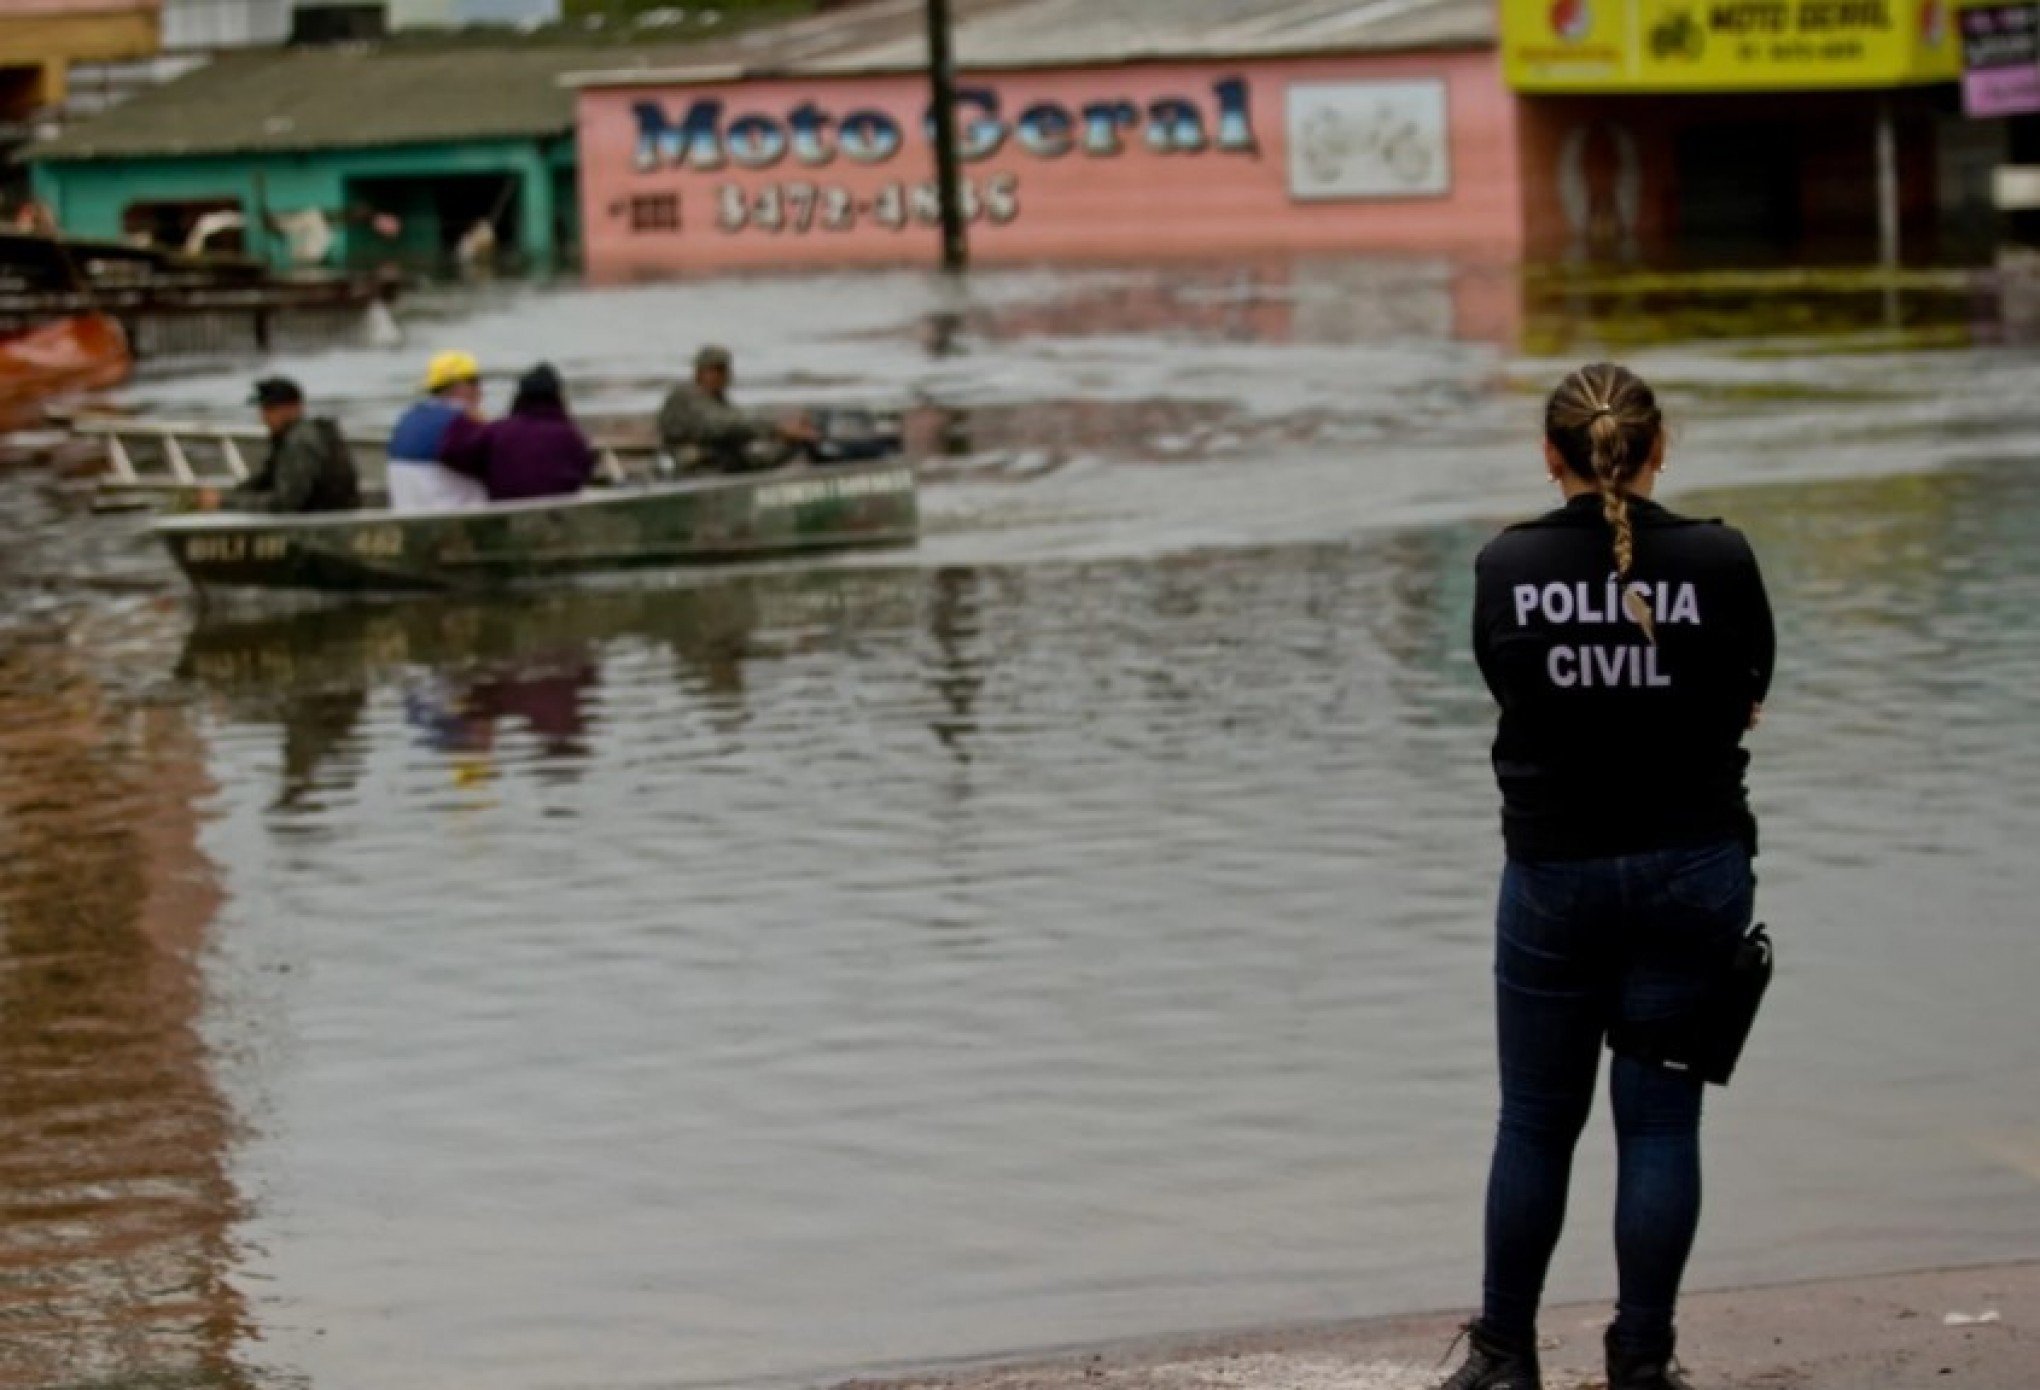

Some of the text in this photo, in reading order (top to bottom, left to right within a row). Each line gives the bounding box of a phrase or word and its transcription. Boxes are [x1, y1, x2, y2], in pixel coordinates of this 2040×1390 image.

[631, 74, 1259, 171] Moto Geral
[1513, 571, 1700, 626] POLÍCIA
[1547, 644, 1671, 687] CIVIL
